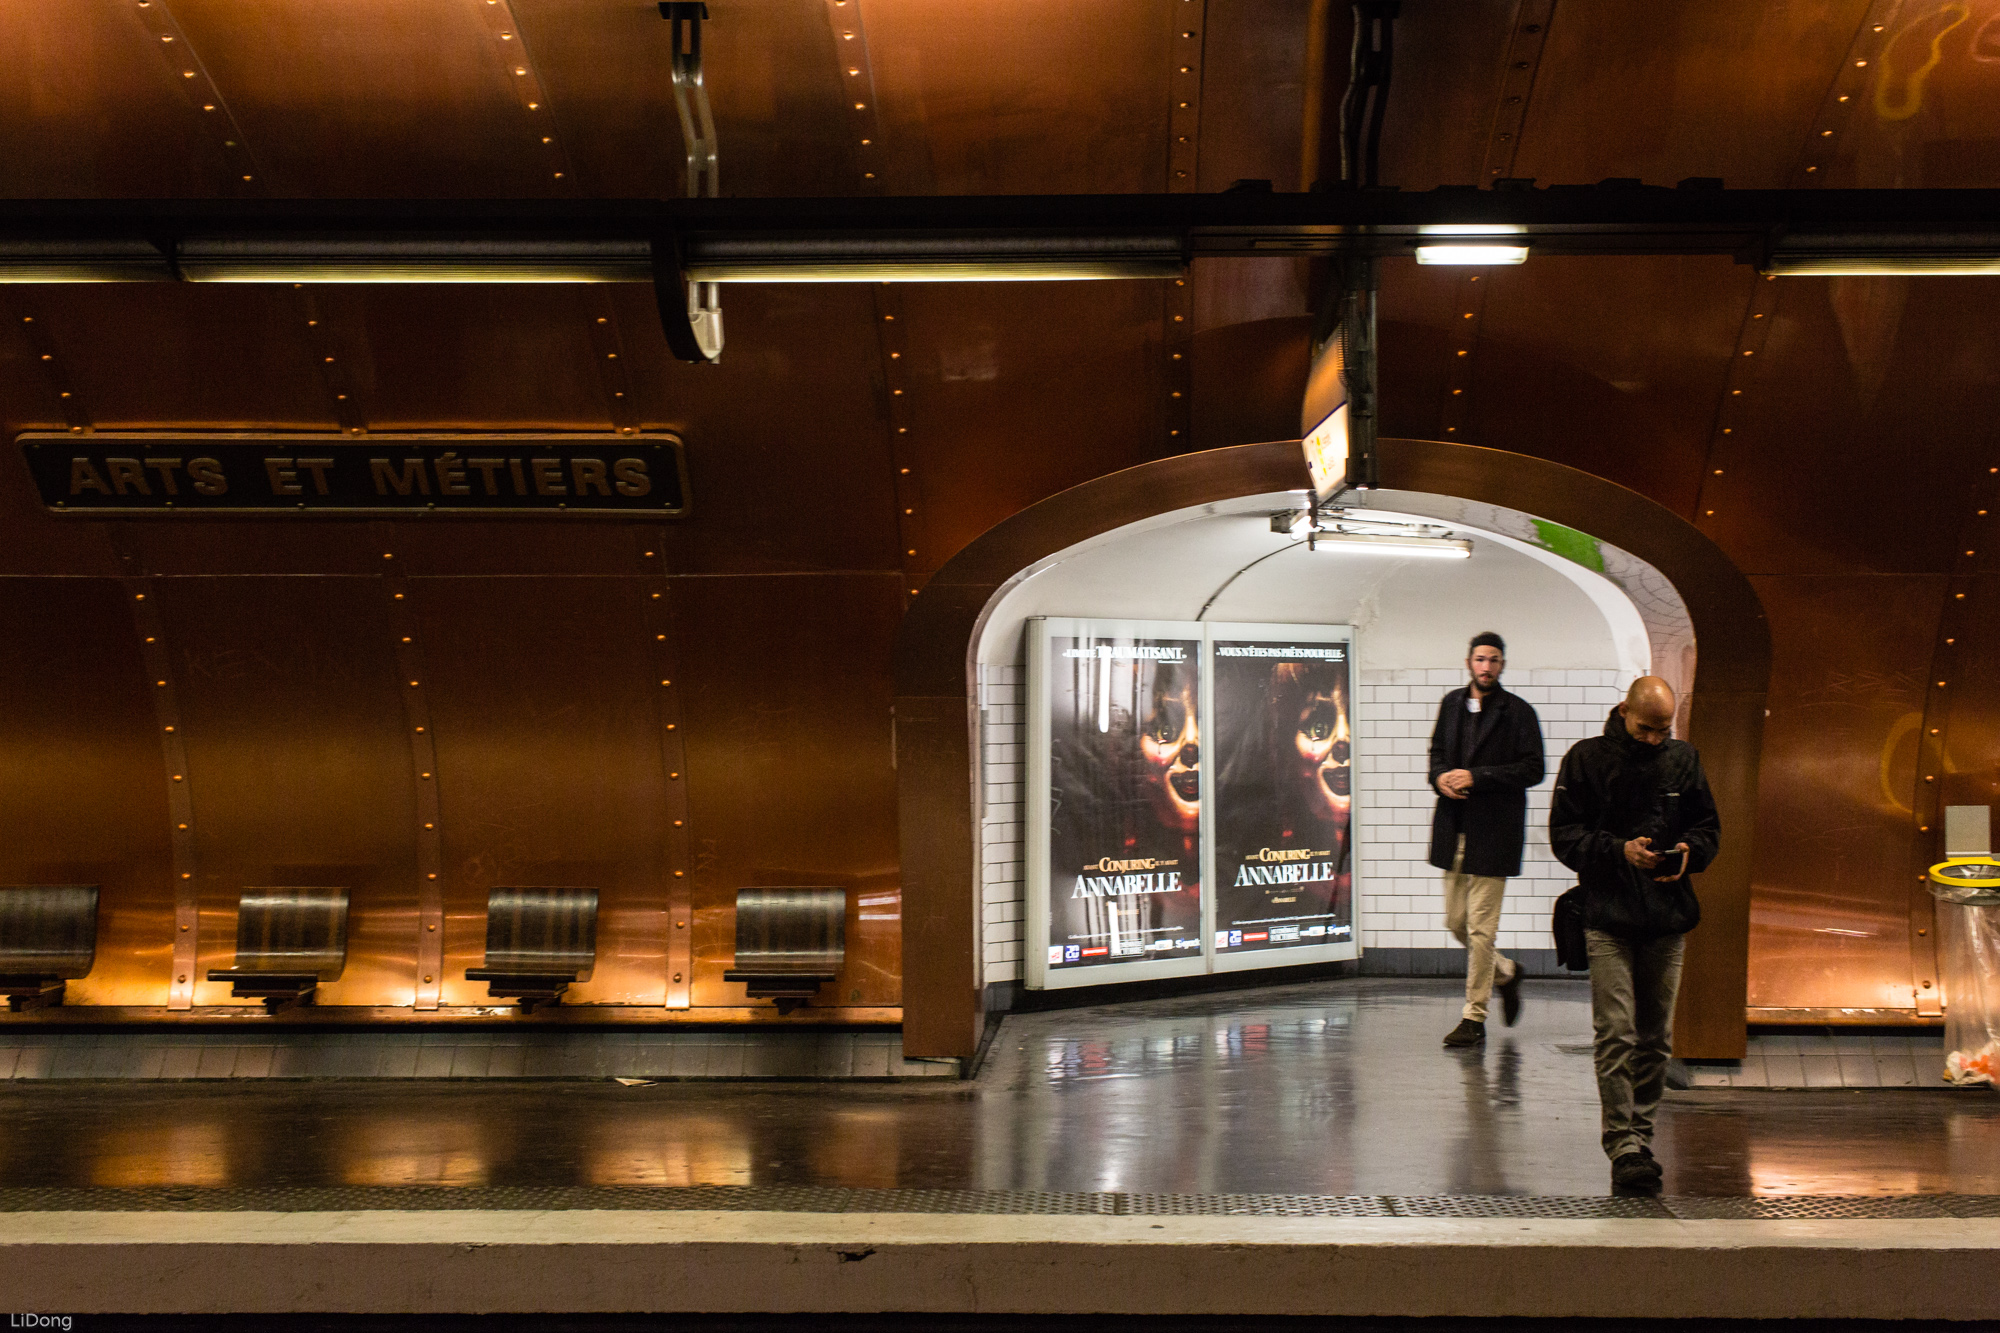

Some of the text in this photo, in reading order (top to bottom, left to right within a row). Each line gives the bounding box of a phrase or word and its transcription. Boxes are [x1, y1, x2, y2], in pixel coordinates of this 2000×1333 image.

[69, 452, 652, 497] ARTS ET MÉTIERS
[1070, 871, 1182, 899] ANNABELLE
[1233, 861, 1335, 887] ANNABELLE
